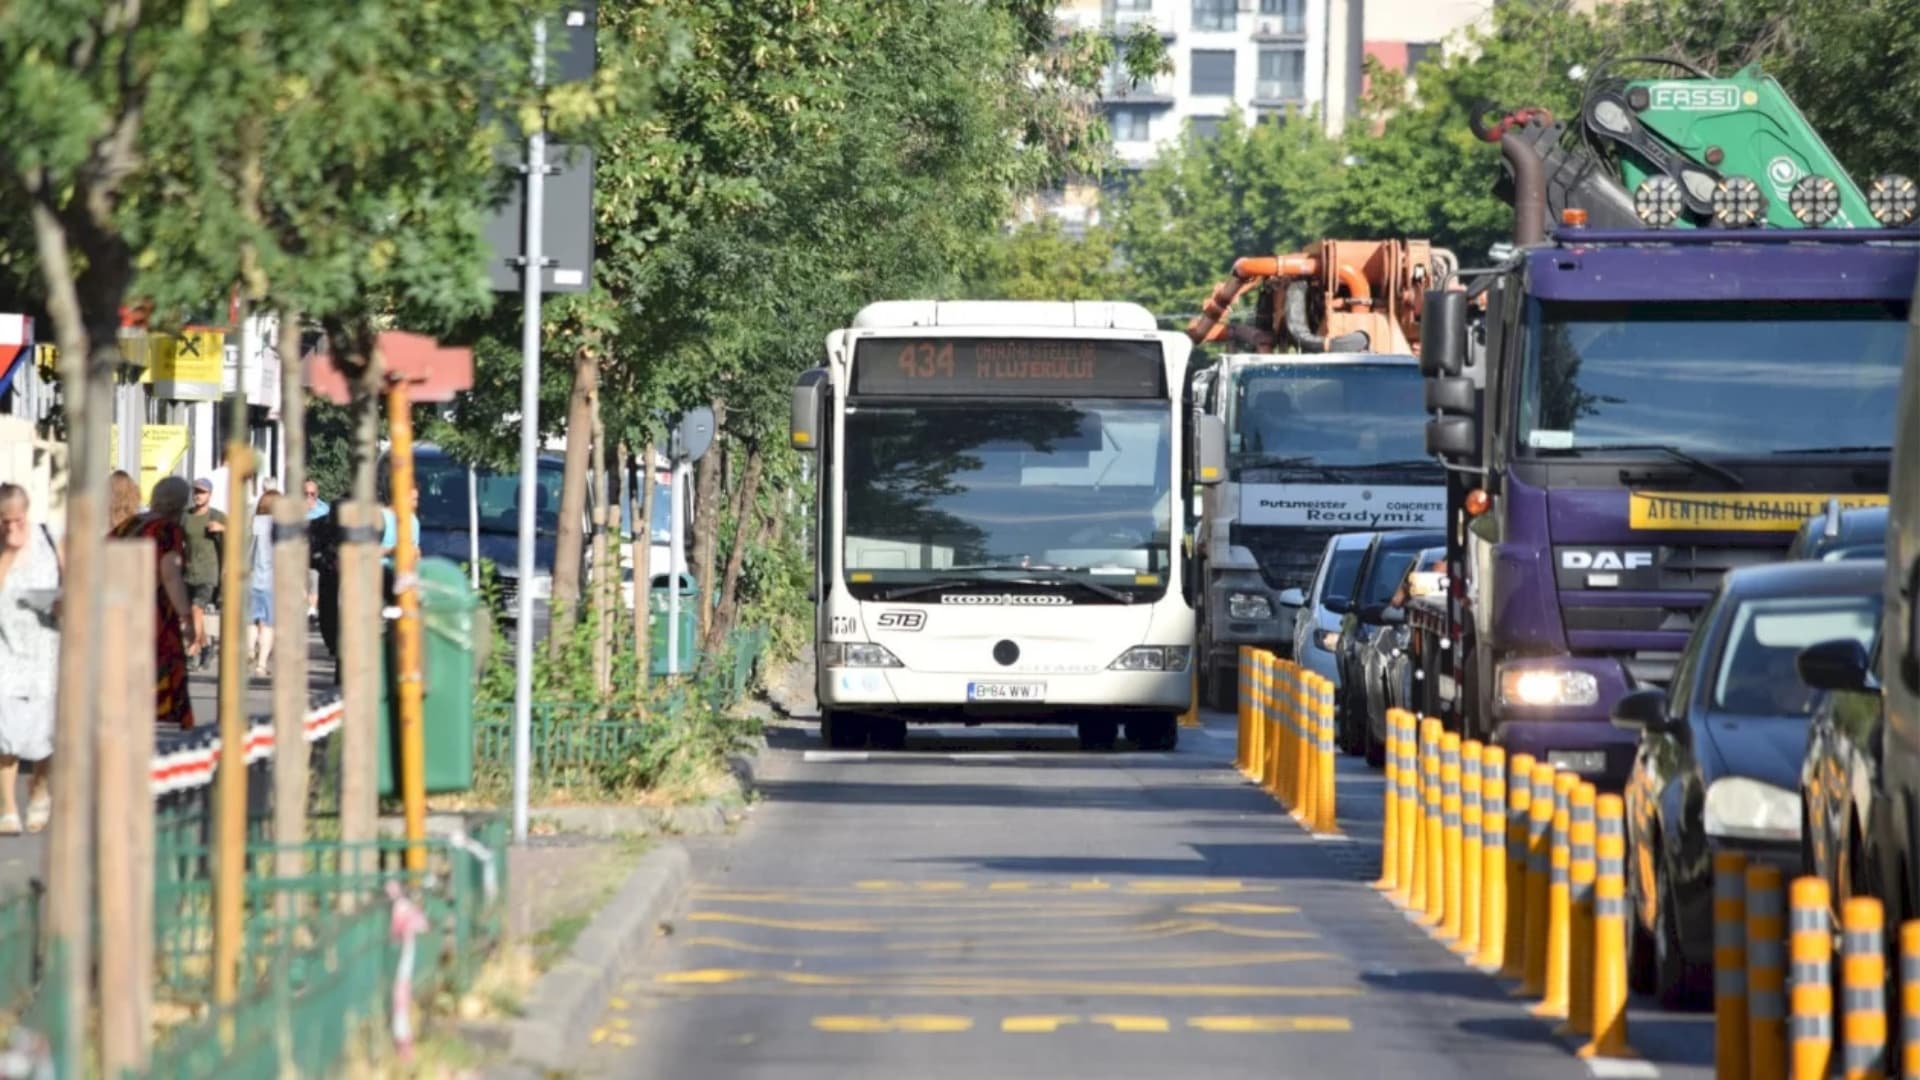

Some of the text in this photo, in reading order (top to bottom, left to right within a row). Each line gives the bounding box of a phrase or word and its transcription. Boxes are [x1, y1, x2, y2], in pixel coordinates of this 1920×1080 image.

[1656, 88, 1733, 106] FASSI
[898, 342, 955, 378] 434
[1386, 502, 1443, 511] CONCRETE
[1307, 509, 1425, 527] Readymix
[1562, 551, 1652, 570] DAF
[877, 613, 922, 627] STB
